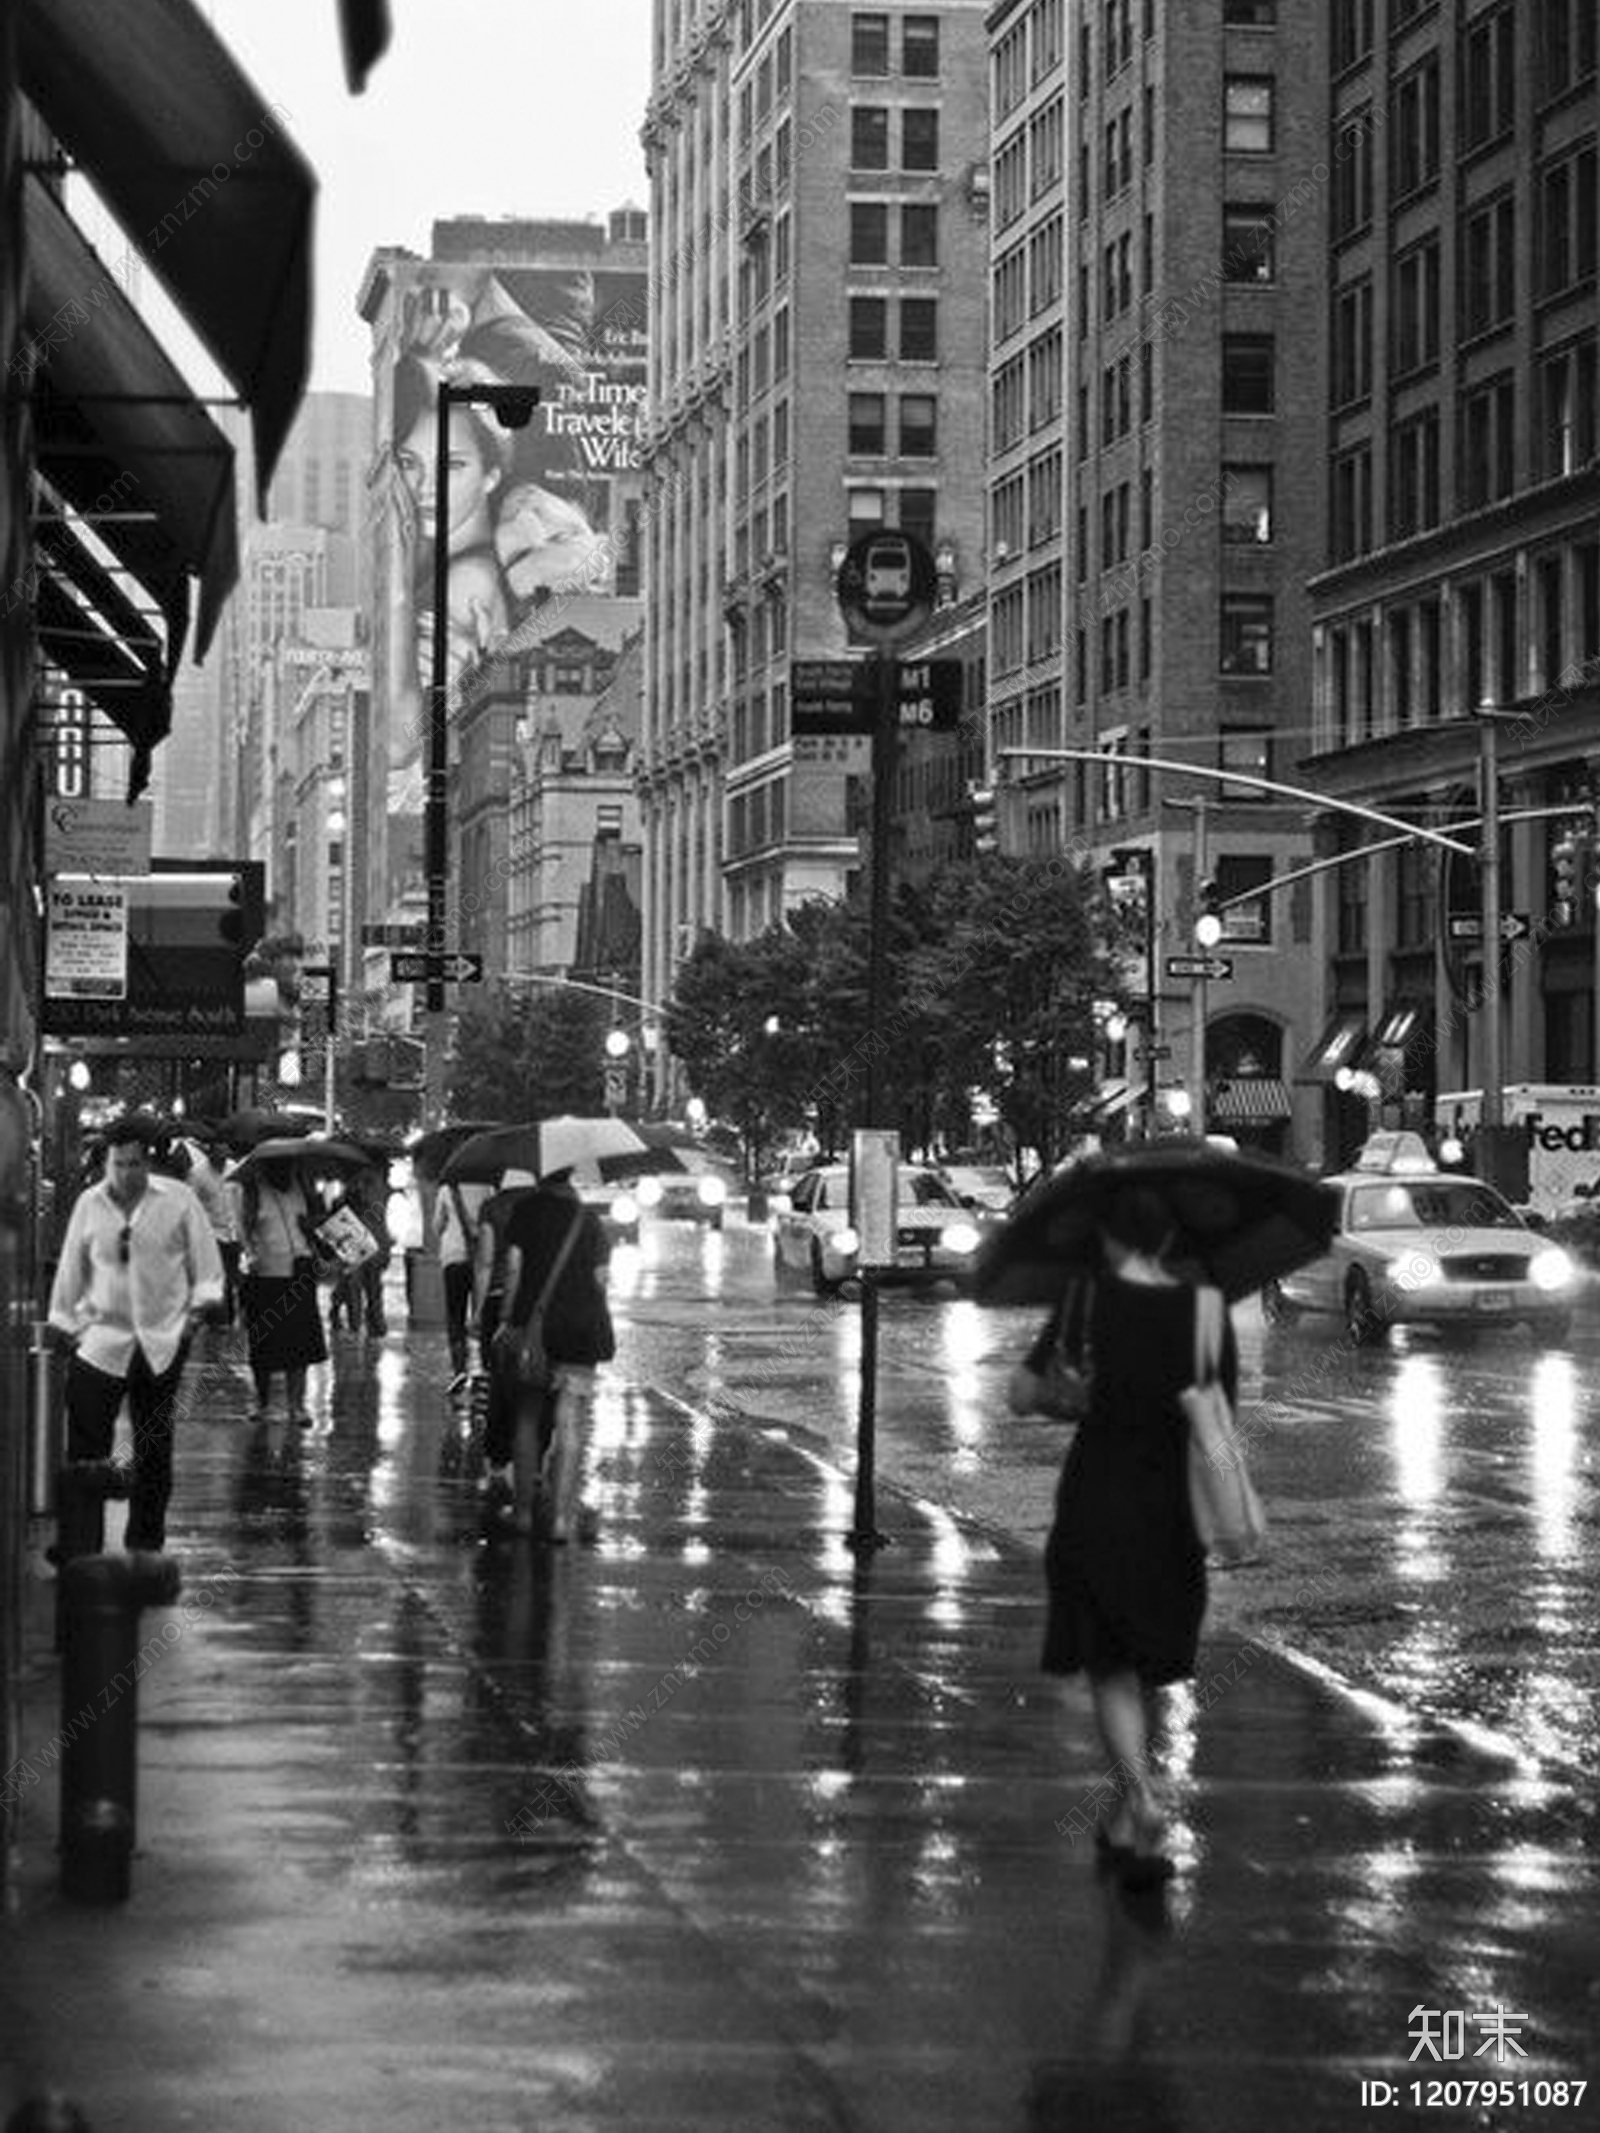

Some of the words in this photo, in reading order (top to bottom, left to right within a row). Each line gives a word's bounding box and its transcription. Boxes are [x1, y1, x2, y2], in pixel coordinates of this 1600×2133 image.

[581, 373, 647, 403] Time
[902, 665, 930, 688] M1
[900, 699, 933, 723] M6
